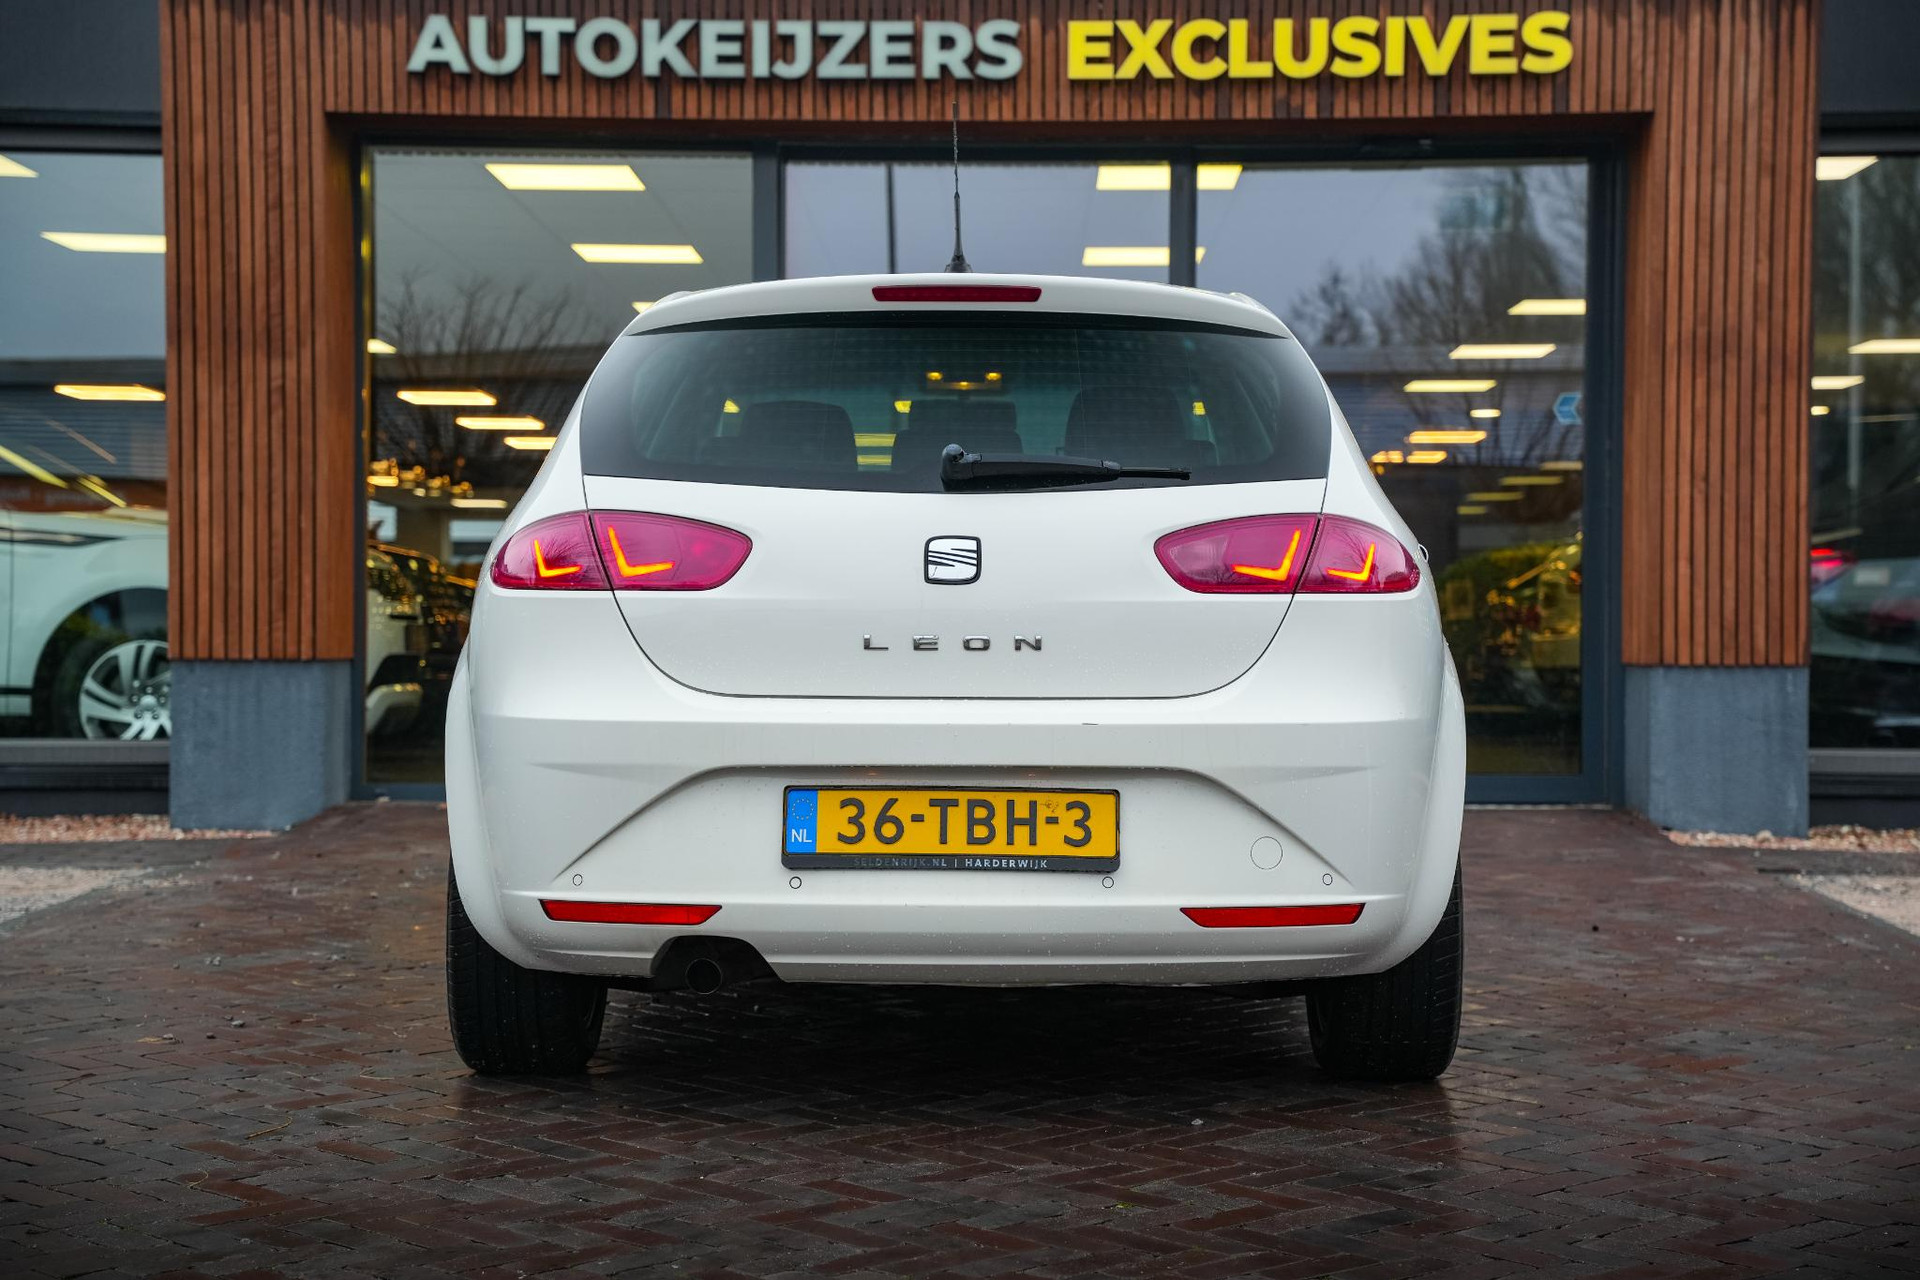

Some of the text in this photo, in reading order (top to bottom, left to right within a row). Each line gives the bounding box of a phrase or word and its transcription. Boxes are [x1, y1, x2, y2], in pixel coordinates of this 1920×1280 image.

[406, 11, 1574, 81] AUTOKEIJZERS EXCLUSIVES
[863, 633, 1043, 652] LEON
[836, 797, 1093, 848] 36-TBH-3
[791, 828, 813, 843] NL
[965, 858, 1048, 868] HARDERWIJK
